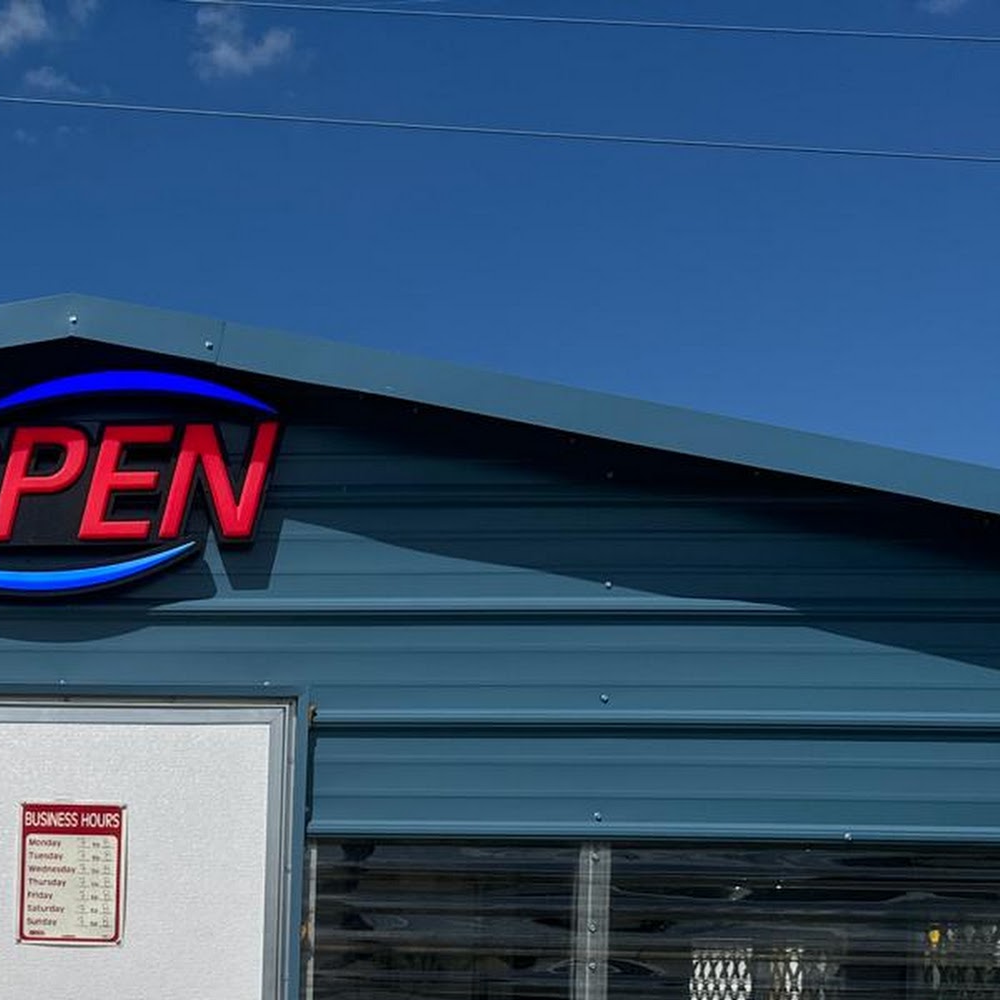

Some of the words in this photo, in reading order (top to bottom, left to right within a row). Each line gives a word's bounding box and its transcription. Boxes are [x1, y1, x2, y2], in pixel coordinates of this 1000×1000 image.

[25, 811, 78, 827] BUSINESS
[80, 813, 120, 828] HOURS
[28, 839, 62, 848] Monday
[28, 852, 64, 861] Tuesday
[28, 865, 77, 874] Wednesday
[28, 878, 67, 887] Thursday
[27, 891, 53, 900] Friday
[27, 904, 65, 913] Saturday
[26, 917, 58, 926] Sunday
